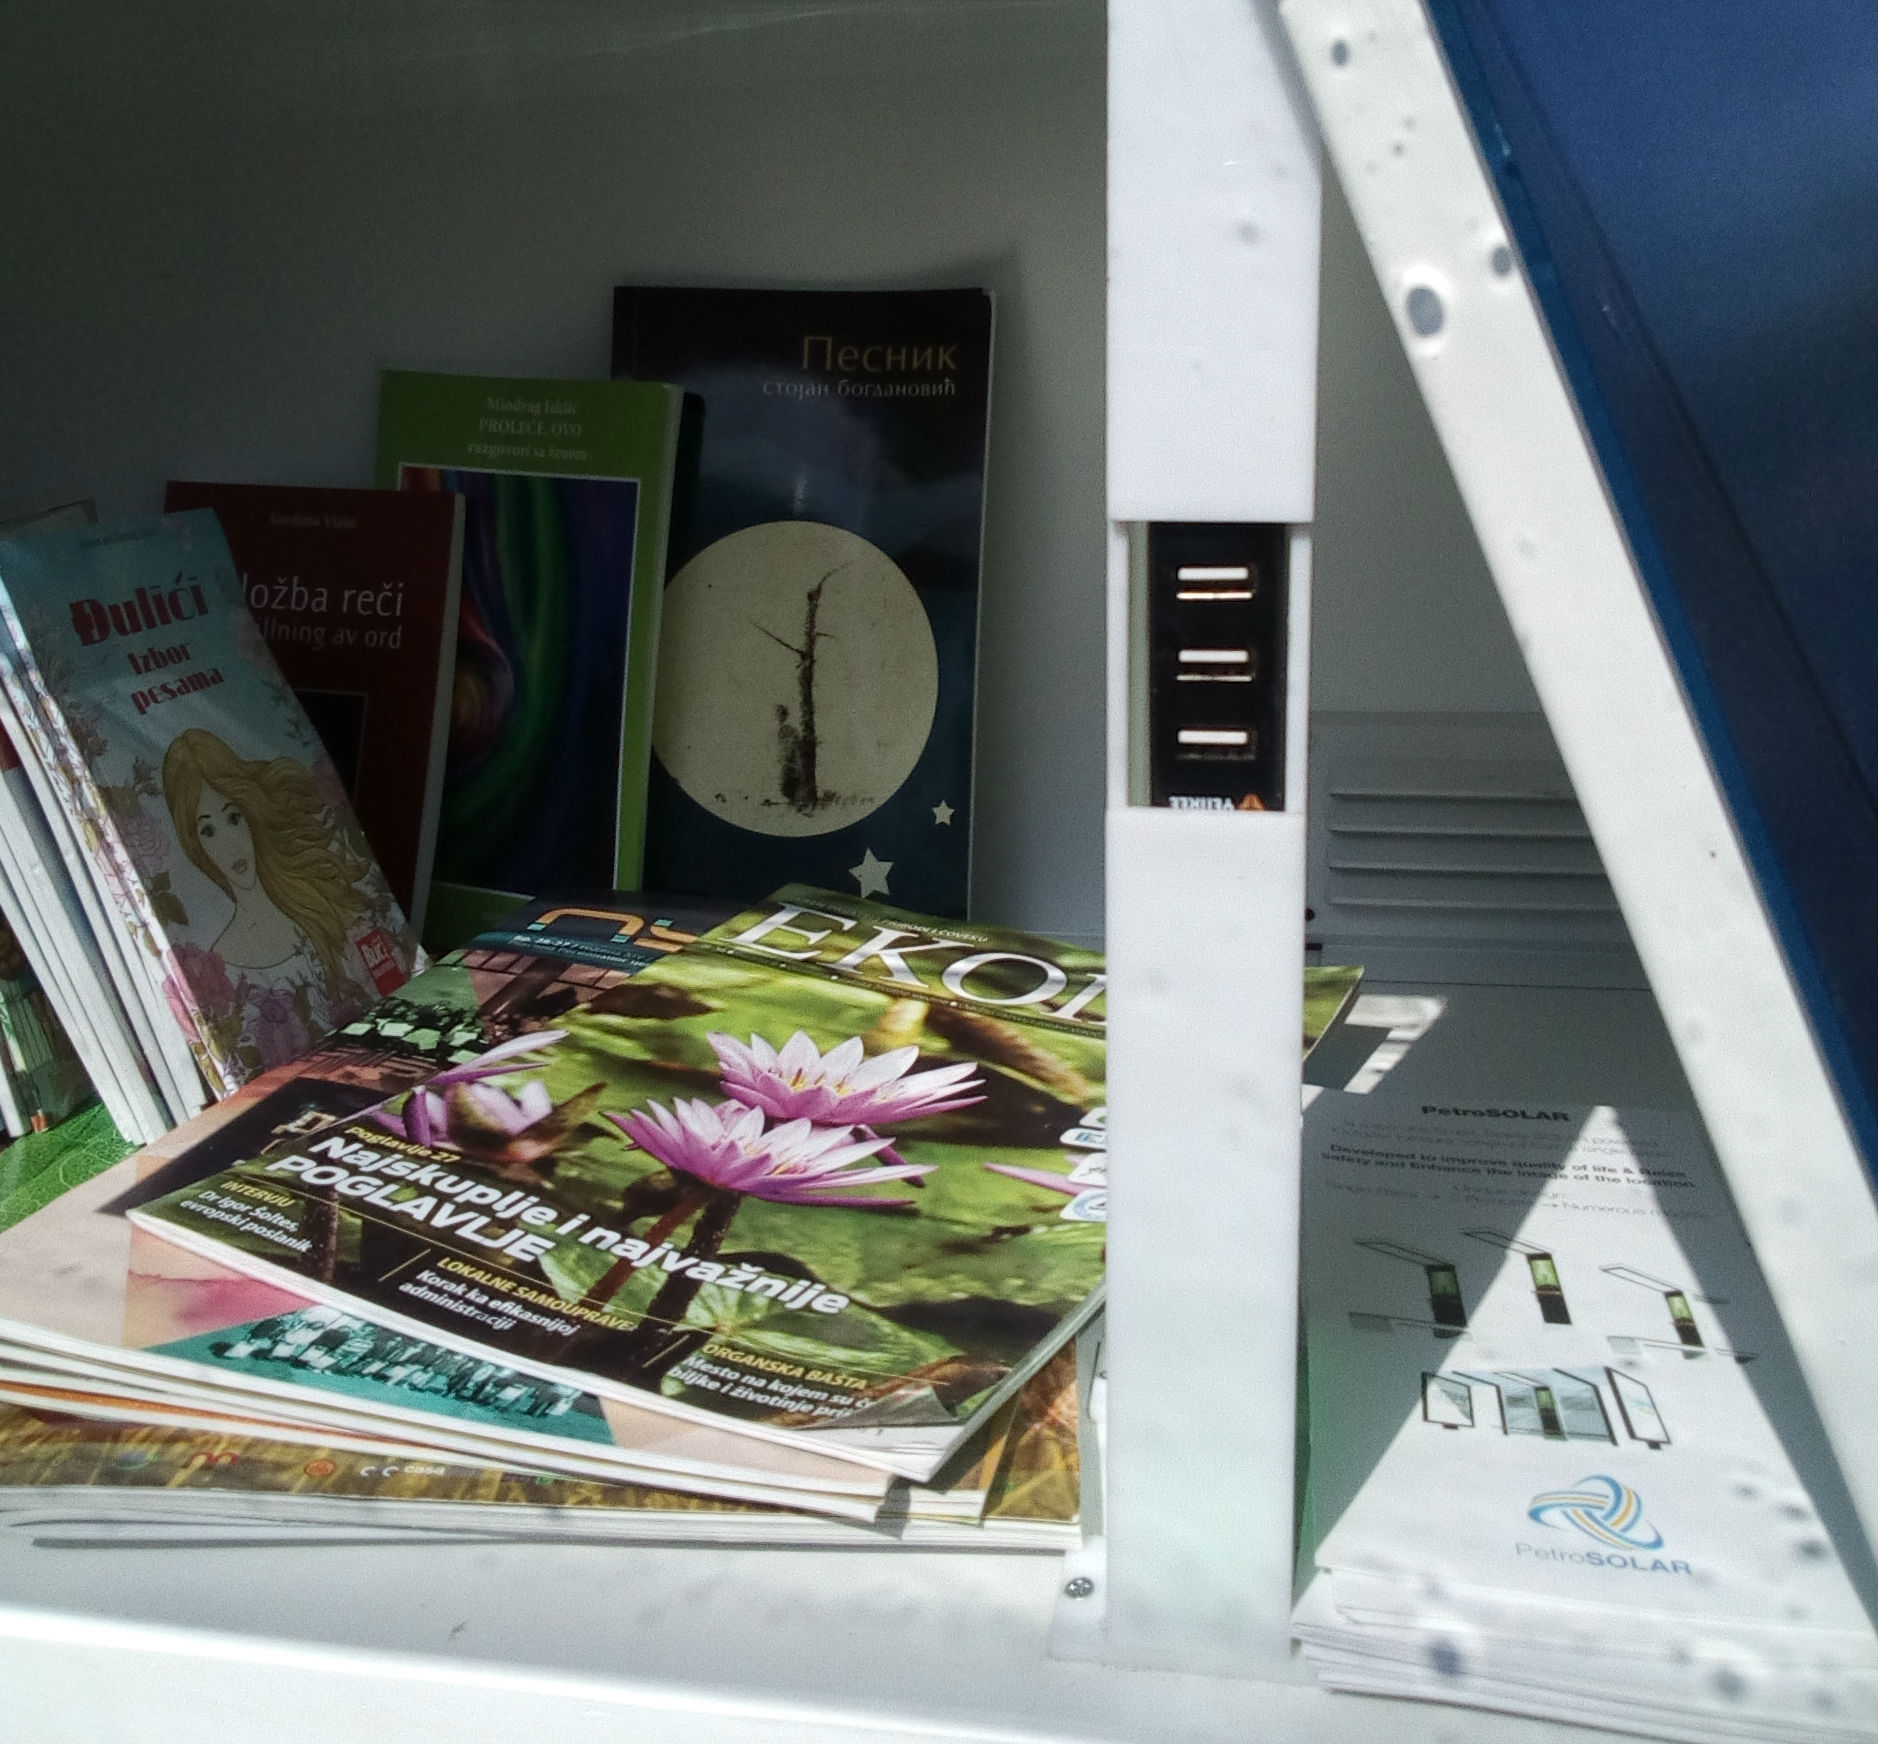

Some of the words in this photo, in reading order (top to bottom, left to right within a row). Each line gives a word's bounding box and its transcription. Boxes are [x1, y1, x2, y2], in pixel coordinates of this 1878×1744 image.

[802, 335, 958, 372] Песник
[838, 377, 957, 397] богдановић
[342, 582, 404, 617] reči
[333, 627, 359, 645] av
[364, 624, 403, 649] ord
[128, 643, 191, 675] Izbor
[131, 668, 225, 715] pesama
[1422, 1105, 1571, 1122] PetroSOLAR
[344, 1126, 433, 1157] Poglavlje
[1330, 1144, 1416, 1159] Developed
[1441, 1154, 1507, 1168] improve
[1572, 1164, 1587, 1172] of
[1592, 1164, 1618, 1173] life
[220, 1180, 297, 1208] INTERVJU
[1595, 1175, 1622, 1184] the
[198, 1190, 221, 1202] Dr
[217, 1196, 254, 1213] Igor
[266, 1154, 556, 1262] POGLAVLJE
[179, 1200, 251, 1227] evropski
[239, 1222, 314, 1253] poslanik
[308, 1136, 561, 1226] Najskuplje
[562, 1214, 588, 1236] i
[580, 1227, 850, 1315] najvažnije
[399, 1282, 517, 1332] administraciji
[415, 1269, 469, 1296] Korak
[465, 1288, 490, 1305] ka
[488, 1298, 581, 1337] efikasnijoj
[436, 1257, 515, 1293] LOKALNE
[511, 1285, 639, 1332] SAMOUPRAVE
[701, 1344, 803, 1378] ORGANSKA
[667, 1367, 722, 1393] biljke
[720, 1383, 733, 1394] i
[729, 1386, 815, 1414] životinje
[682, 1356, 741, 1382] Mesto
[740, 1373, 767, 1389] na
[767, 1378, 830, 1402] kojem
[829, 1393, 855, 1406] su
[1515, 1542, 1693, 1576] PetroSOLAR
